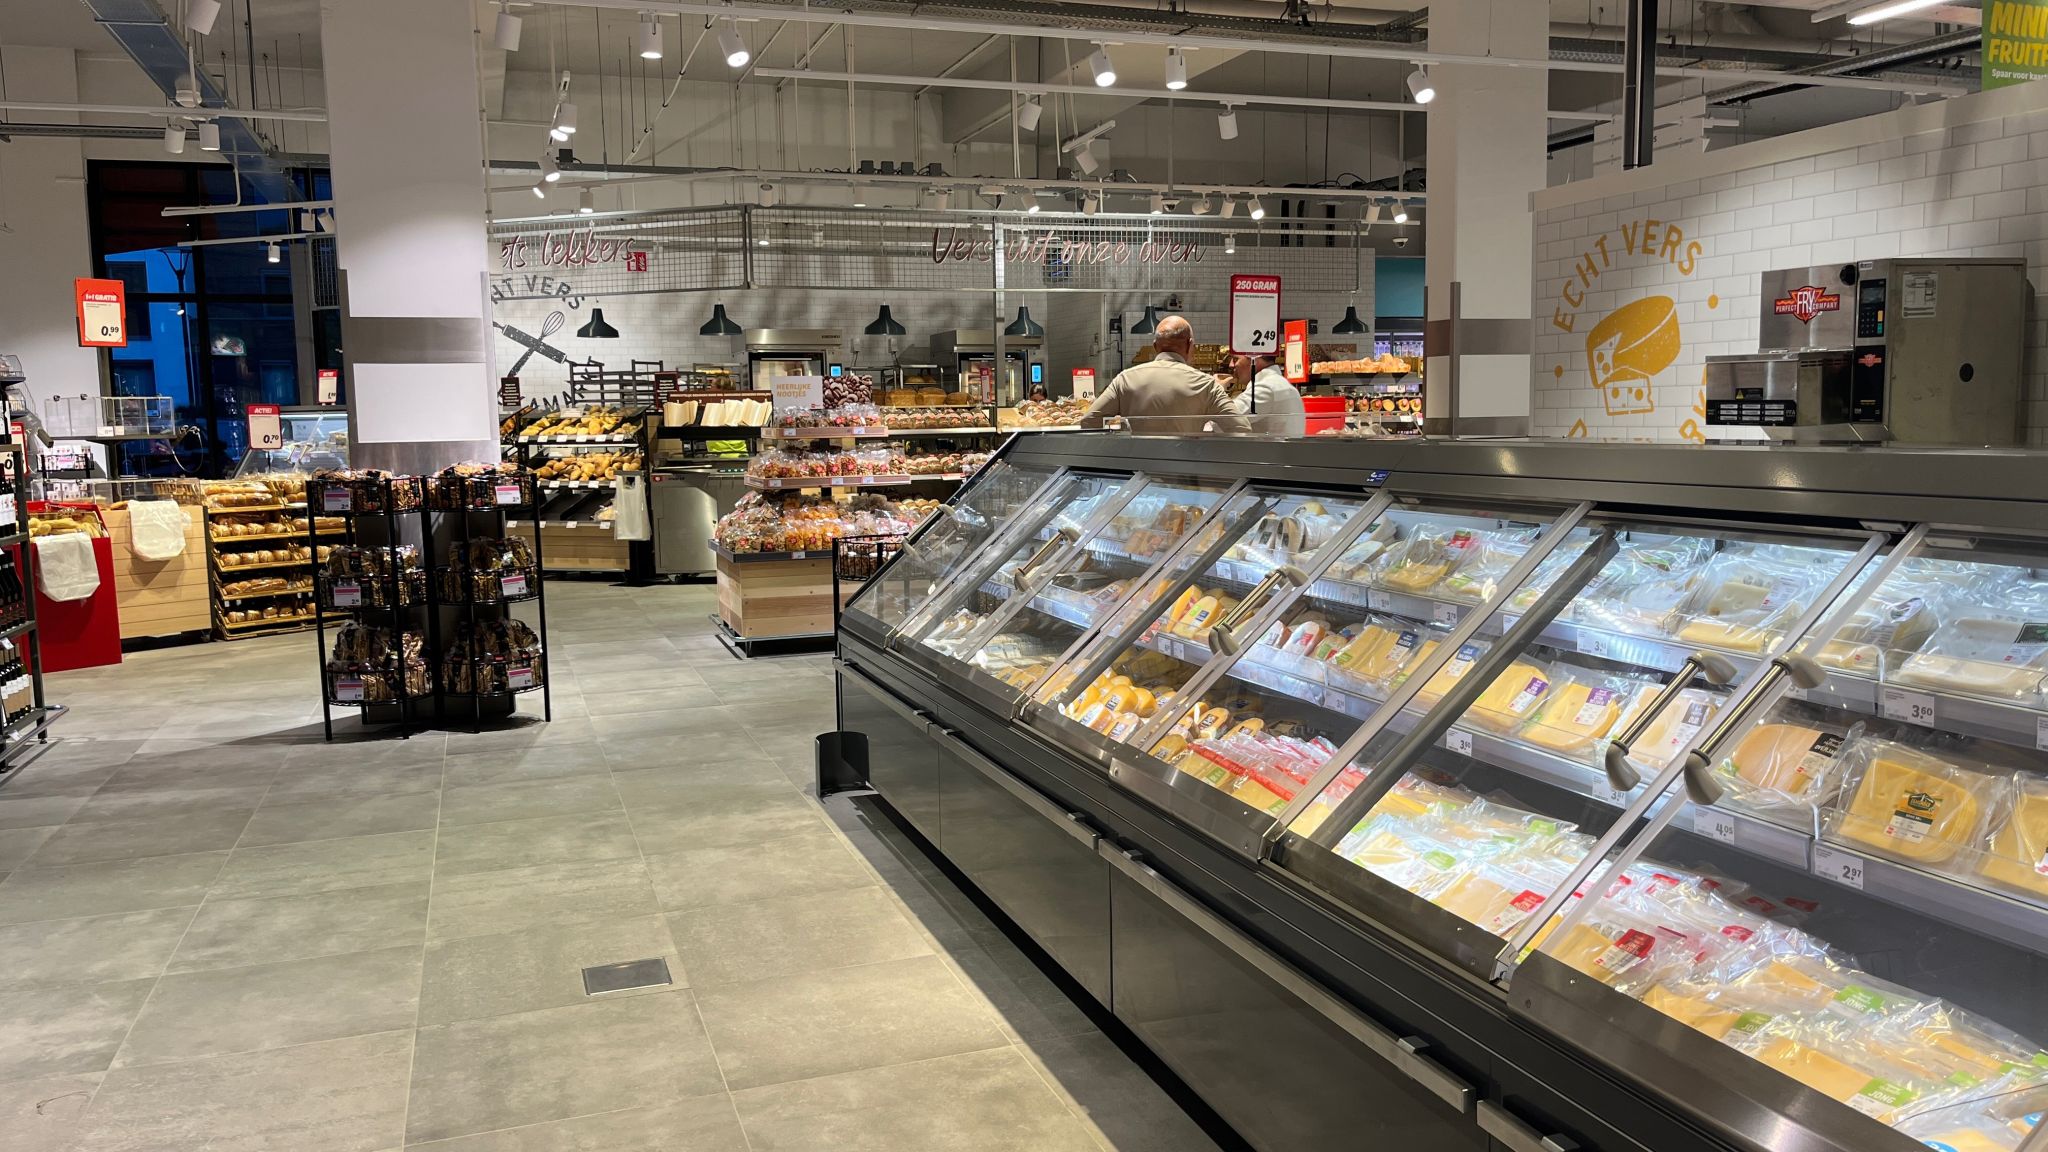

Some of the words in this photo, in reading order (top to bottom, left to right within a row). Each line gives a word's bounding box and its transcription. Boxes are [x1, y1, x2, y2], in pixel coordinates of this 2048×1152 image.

[2013, 71, 2028, 80] voor
[541, 229, 635, 269] lekkers
[932, 224, 993, 264] Vers
[1007, 230, 1060, 266] uit
[1060, 239, 1131, 265] onze
[1139, 238, 1207, 265] oven
[1553, 235, 1610, 333] ECHT
[1621, 219, 1703, 276] VERS
[524, 274, 584, 310] VERS
[1236, 280, 1252, 290] 250
[1252, 280, 1277, 291] GRAM
[1797, 290, 1815, 315] FRY
[101, 325, 120, 337] 0.99
[1251, 329, 1276, 347] 2.49
[777, 390, 807, 398] NOOTJES
[263, 434, 280, 444] 0.70
[1912, 704, 1934, 719] 3.60
[1842, 865, 1862, 881] 2.97
[1868, 1090, 1896, 1104] JONG
